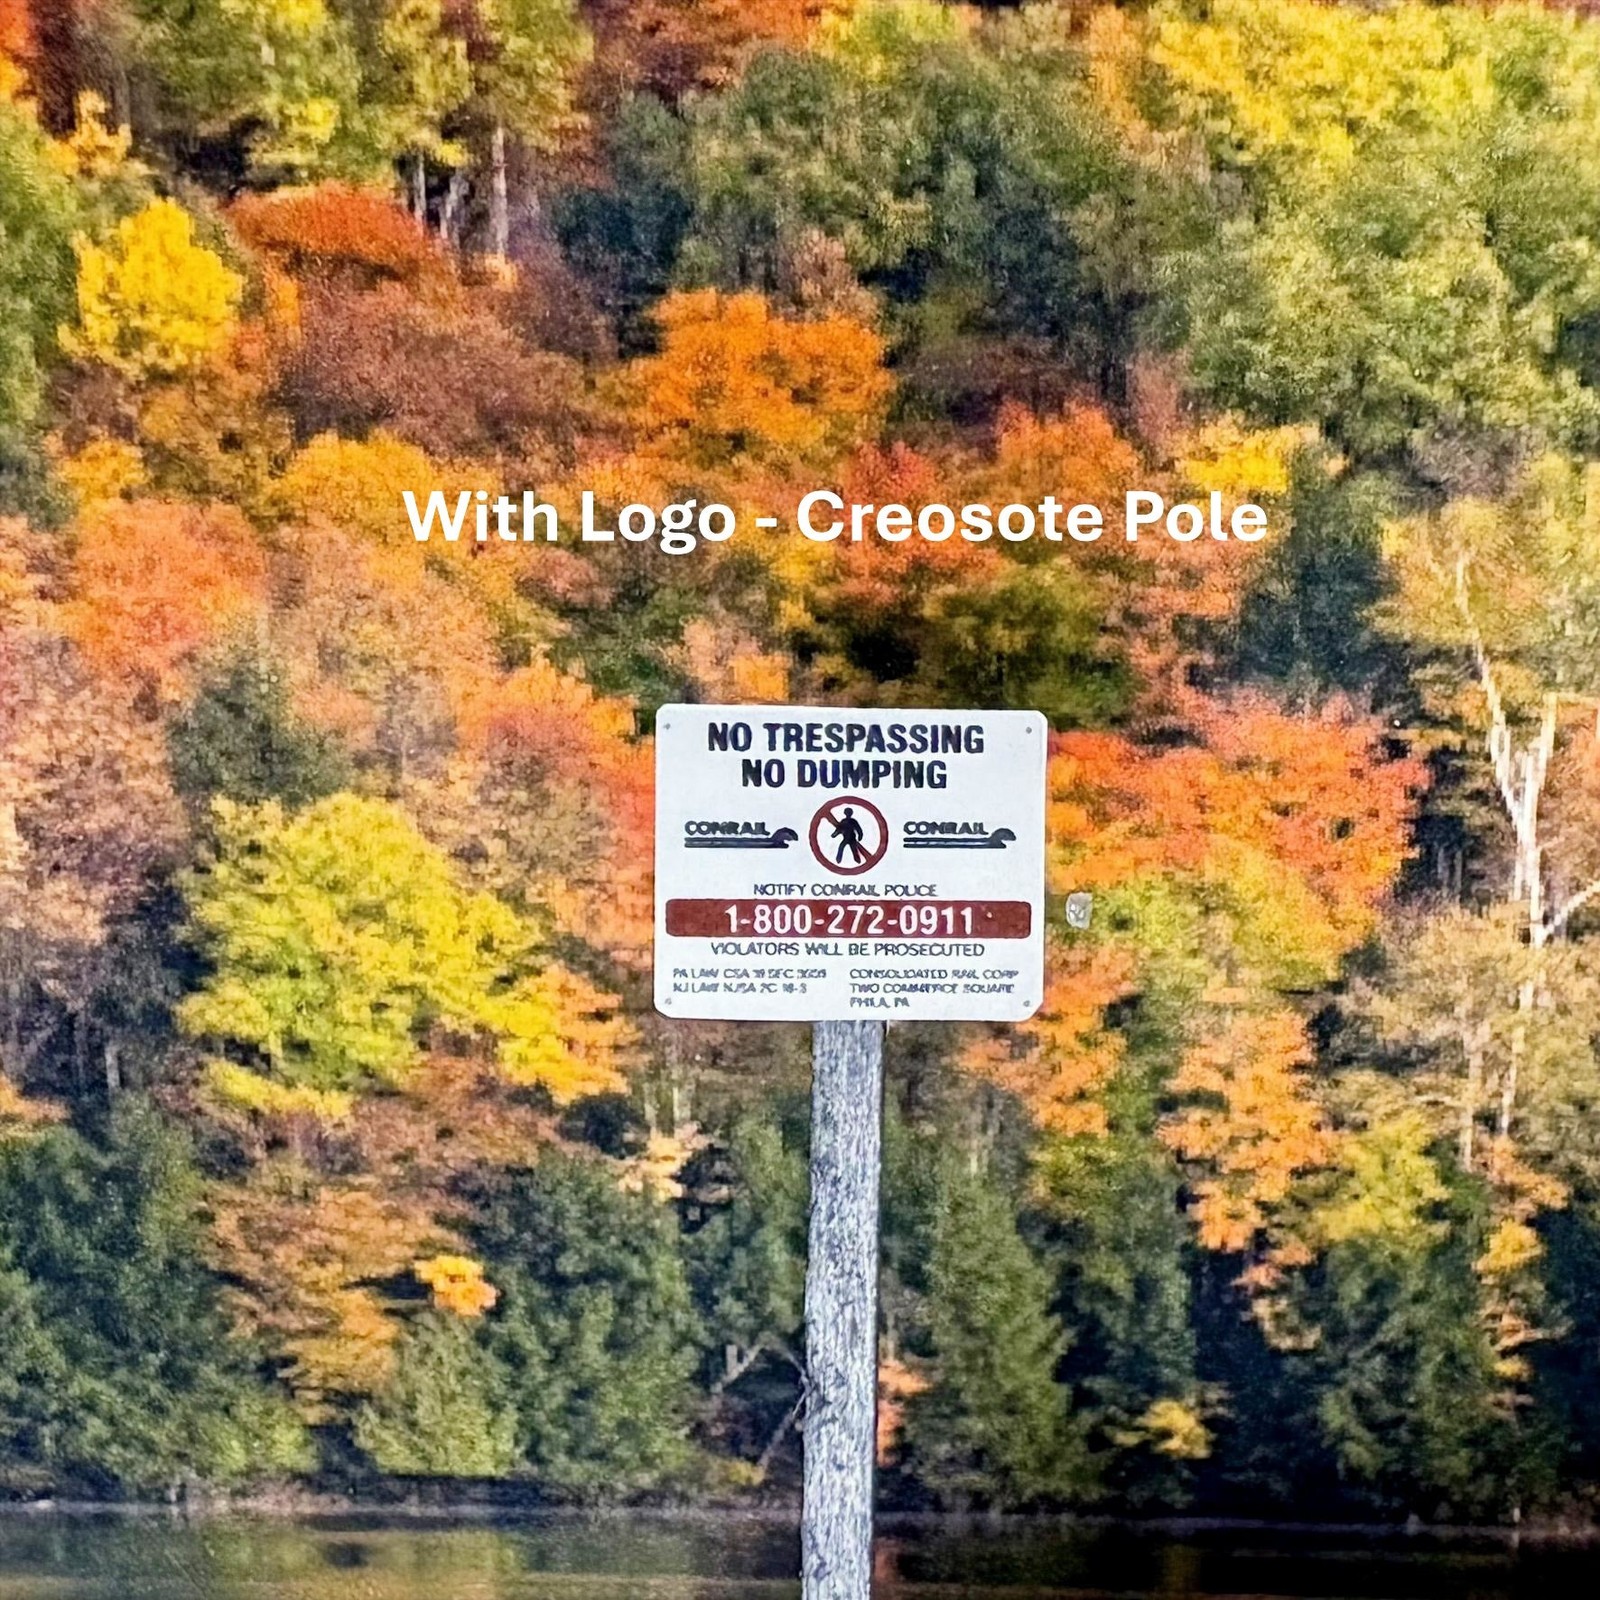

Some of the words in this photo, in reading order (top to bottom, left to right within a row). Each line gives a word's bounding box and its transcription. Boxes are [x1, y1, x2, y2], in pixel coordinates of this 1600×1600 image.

[707, 721, 753, 753] NO
[762, 722, 985, 755] TRESPASSING
[741, 758, 786, 789] NO
[796, 758, 948, 790] DUMPING
[753, 883, 807, 897] NOTIFY
[810, 883, 881, 898] CONRAIL
[884, 883, 938, 898] POLICE
[724, 904, 972, 935] 1-800-272-0911
[710, 941, 800, 956] VIOLATORS
[804, 942, 844, 956] WILL
[848, 942, 871, 957] BE
[873, 942, 986, 957] PROSECUTED
